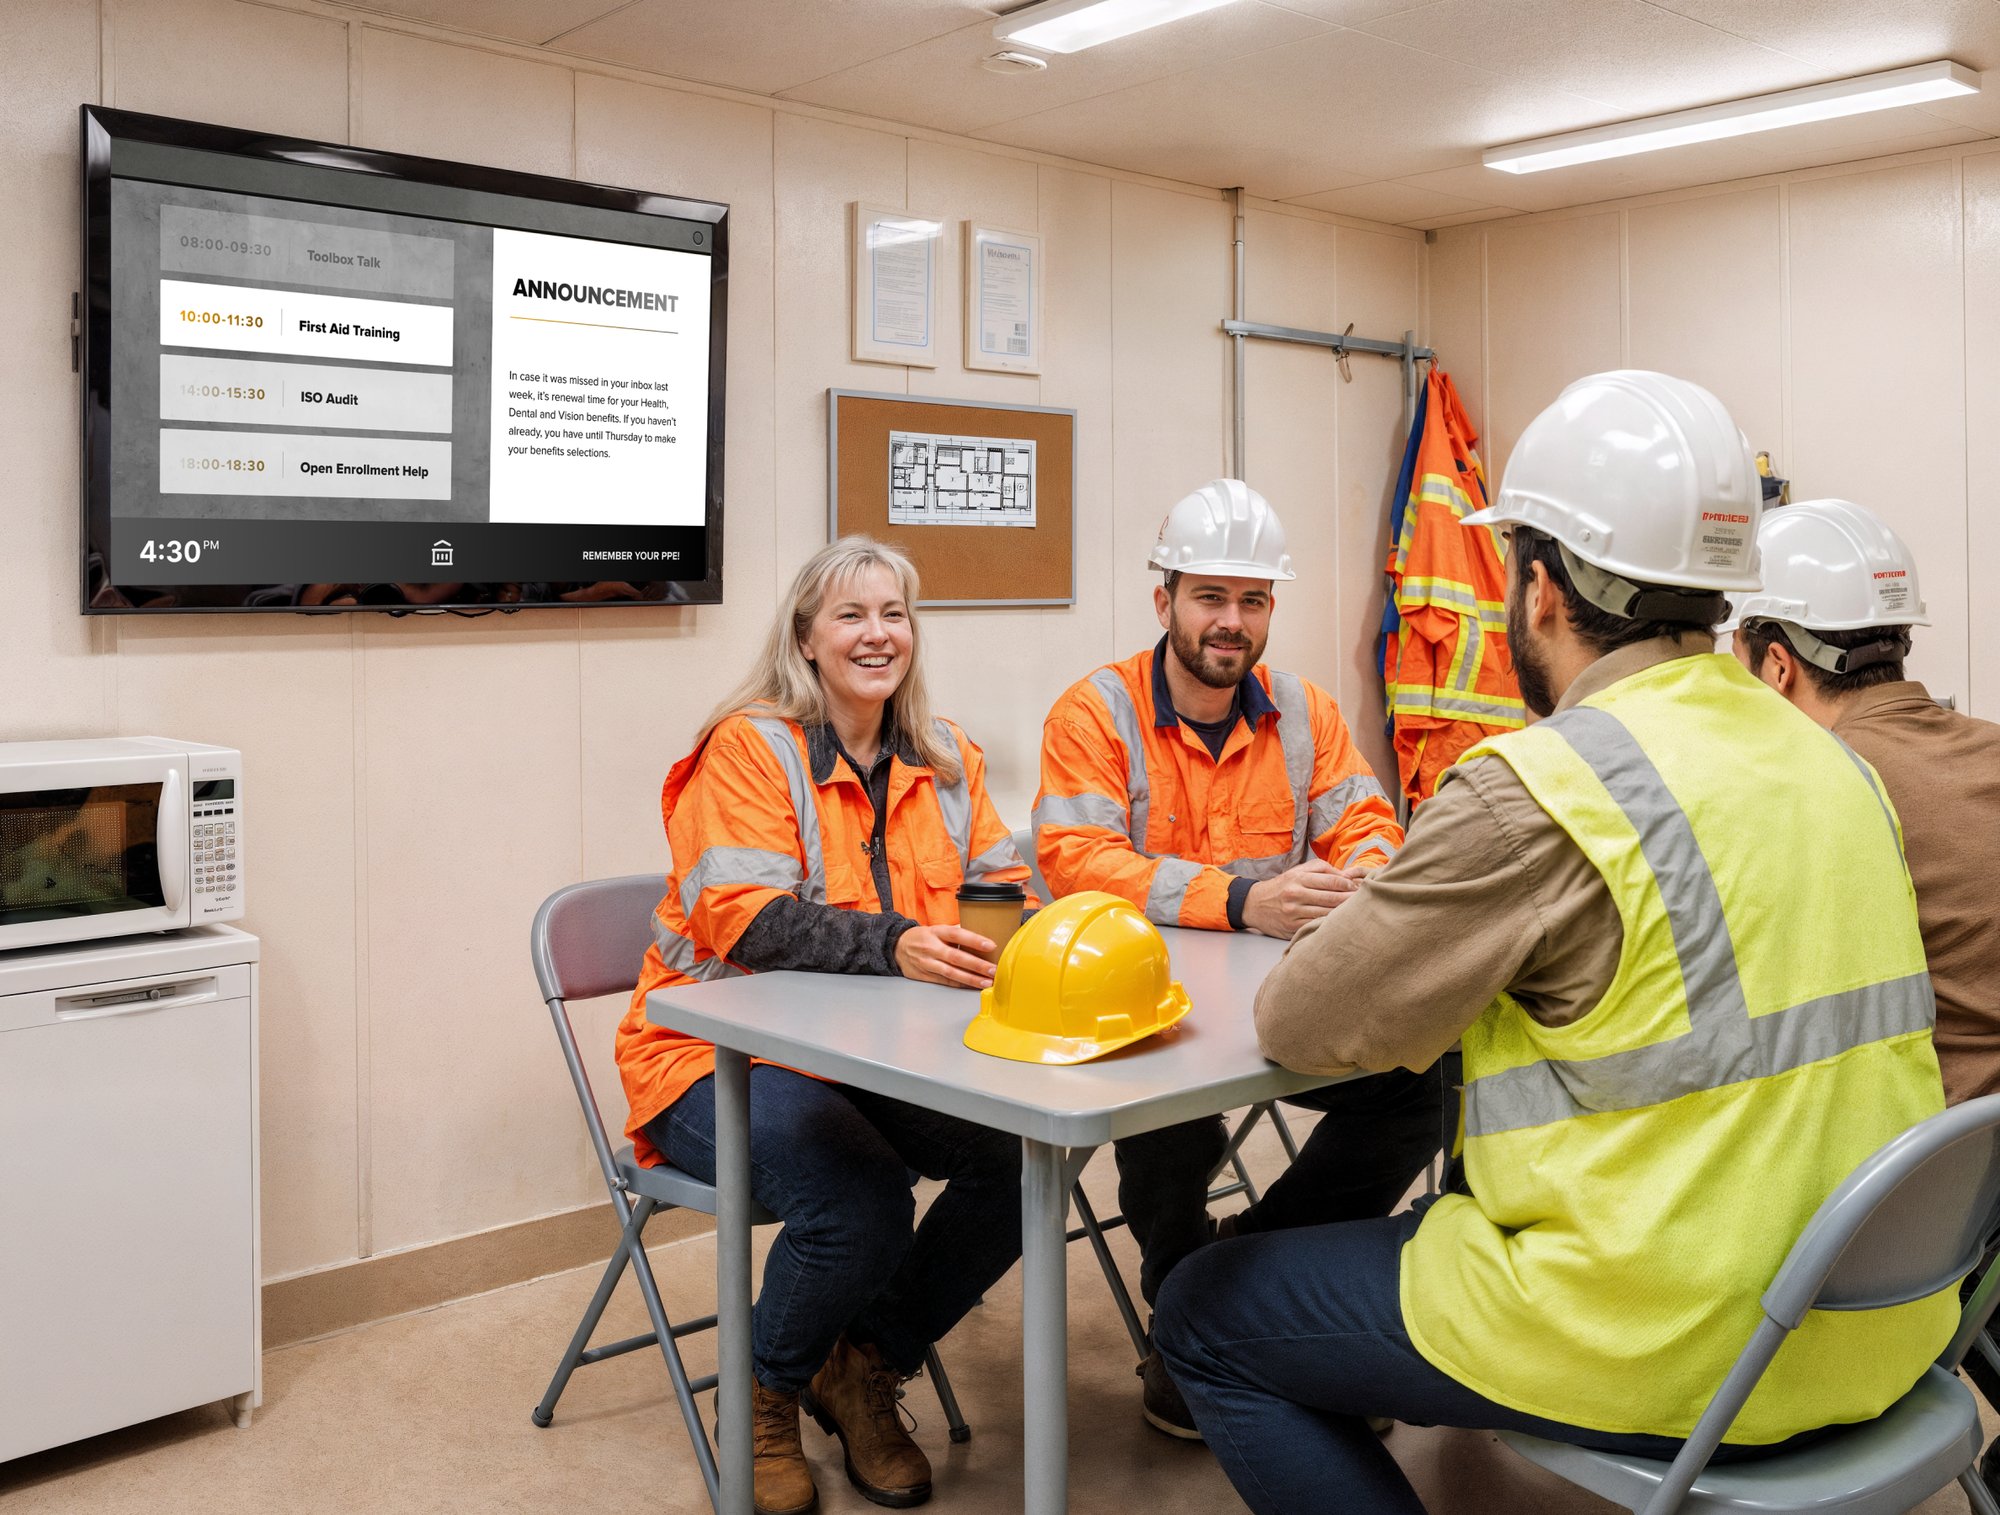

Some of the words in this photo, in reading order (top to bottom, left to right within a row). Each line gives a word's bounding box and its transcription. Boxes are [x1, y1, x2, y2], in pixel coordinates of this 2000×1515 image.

[180, 235, 271, 256] 08:00-09:30
[307, 250, 353, 265] Toolbox
[357, 256, 380, 268] Talk
[512, 278, 678, 312] ANNOUNCEMENT
[180, 310, 263, 328] 10:00-11:30
[299, 320, 326, 333] First
[329, 323, 349, 335] Aid
[353, 325, 400, 342] Training
[510, 371, 517, 380] In
[520, 374, 540, 382] case
[543, 374, 548, 382] it
[550, 376, 567, 384] was
[570, 376, 599, 386] missed
[601, 378, 608, 386] in
[611, 381, 629, 390] your
[631, 380, 652, 390] inbox
[655, 382, 668, 391] last
[180, 384, 265, 400] 14:00-15:30
[301, 391, 323, 403] ISO
[326, 393, 358, 405] Audit
[509, 391, 535, 400] week,
[538, 391, 549, 401] it's
[552, 394, 585, 403] renewal
[588, 395, 605, 404] time
[608, 396, 619, 405] for
[621, 399, 638, 409] your
[641, 399, 668, 409] Health,
[509, 408, 537, 418] Dental
[540, 411, 556, 419] and
[558, 411, 584, 420] Vision
[587, 413, 621, 423] benefits.
[624, 415, 629, 423] If
[631, 417, 645, 427] you
[648, 416, 676, 426] haven't
[509, 427, 542, 439] already,
[545, 430, 560, 440] you
[563, 429, 583, 439] have
[586, 431, 603, 439] until
[606, 431, 642, 443] Thursday
[645, 434, 652, 442] to
[655, 435, 676, 443] make
[508, 447, 528, 457] your
[530, 446, 564, 456] benefits
[567, 448, 610, 457] selections.
[180, 457, 265, 472] 18:00-18:30
[300, 462, 332, 476] Open
[336, 463, 400, 476] Enrollment
[403, 466, 428, 479] Help
[583, 551, 632, 560] REMEMBER
[635, 552, 659, 560] YOUR
[662, 552, 679, 560] PPE!
